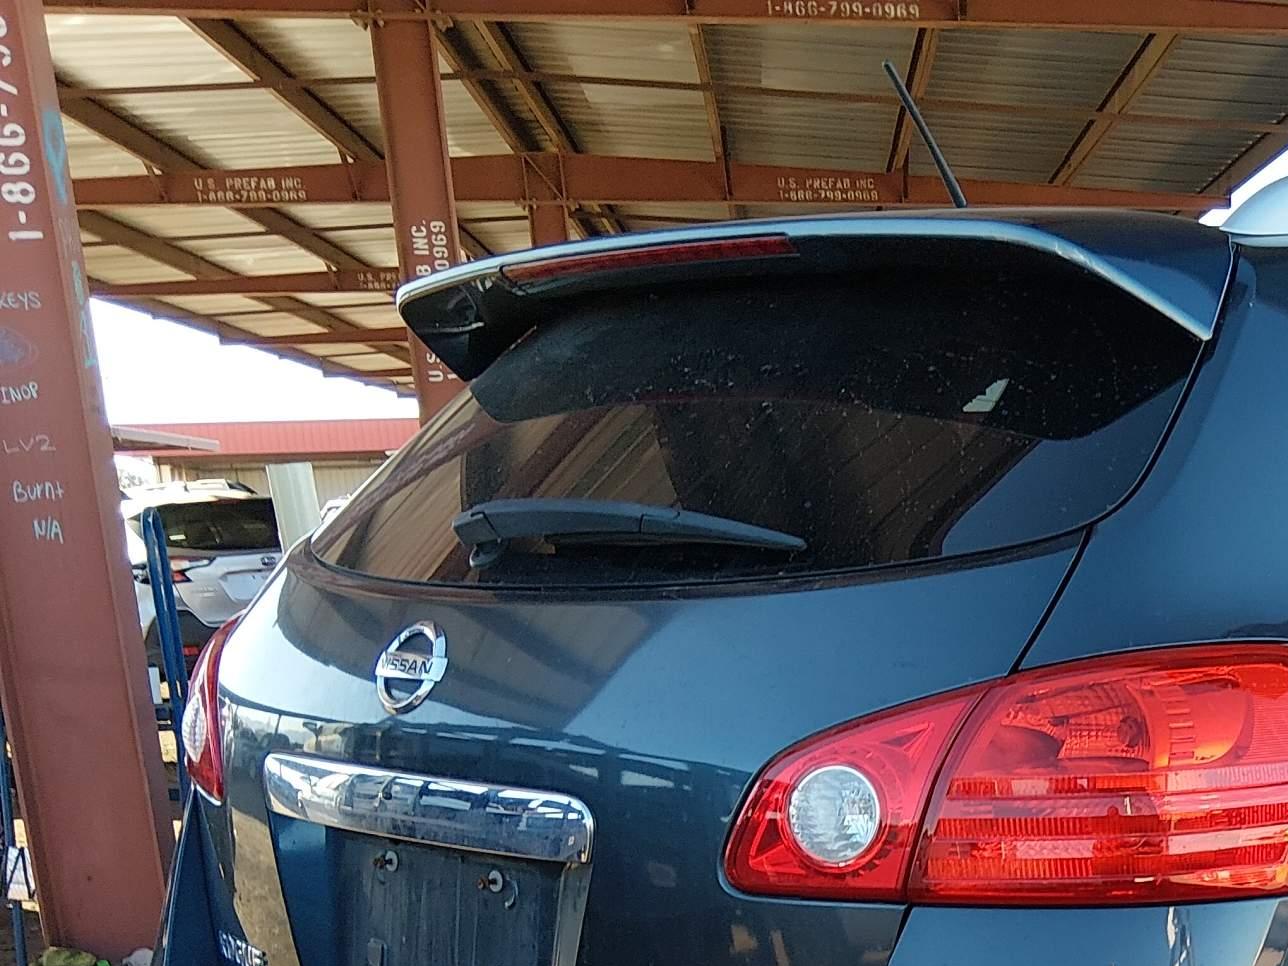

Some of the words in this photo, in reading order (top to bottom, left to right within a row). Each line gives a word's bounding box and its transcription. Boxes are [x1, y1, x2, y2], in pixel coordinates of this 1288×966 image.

[225, 177, 275, 190] PREFAB
[805, 177, 851, 190] PREFAB
[411, 219, 430, 256] INC.
[33, 516, 64, 544] N/A
[381, 656, 434, 675] NISSAN
